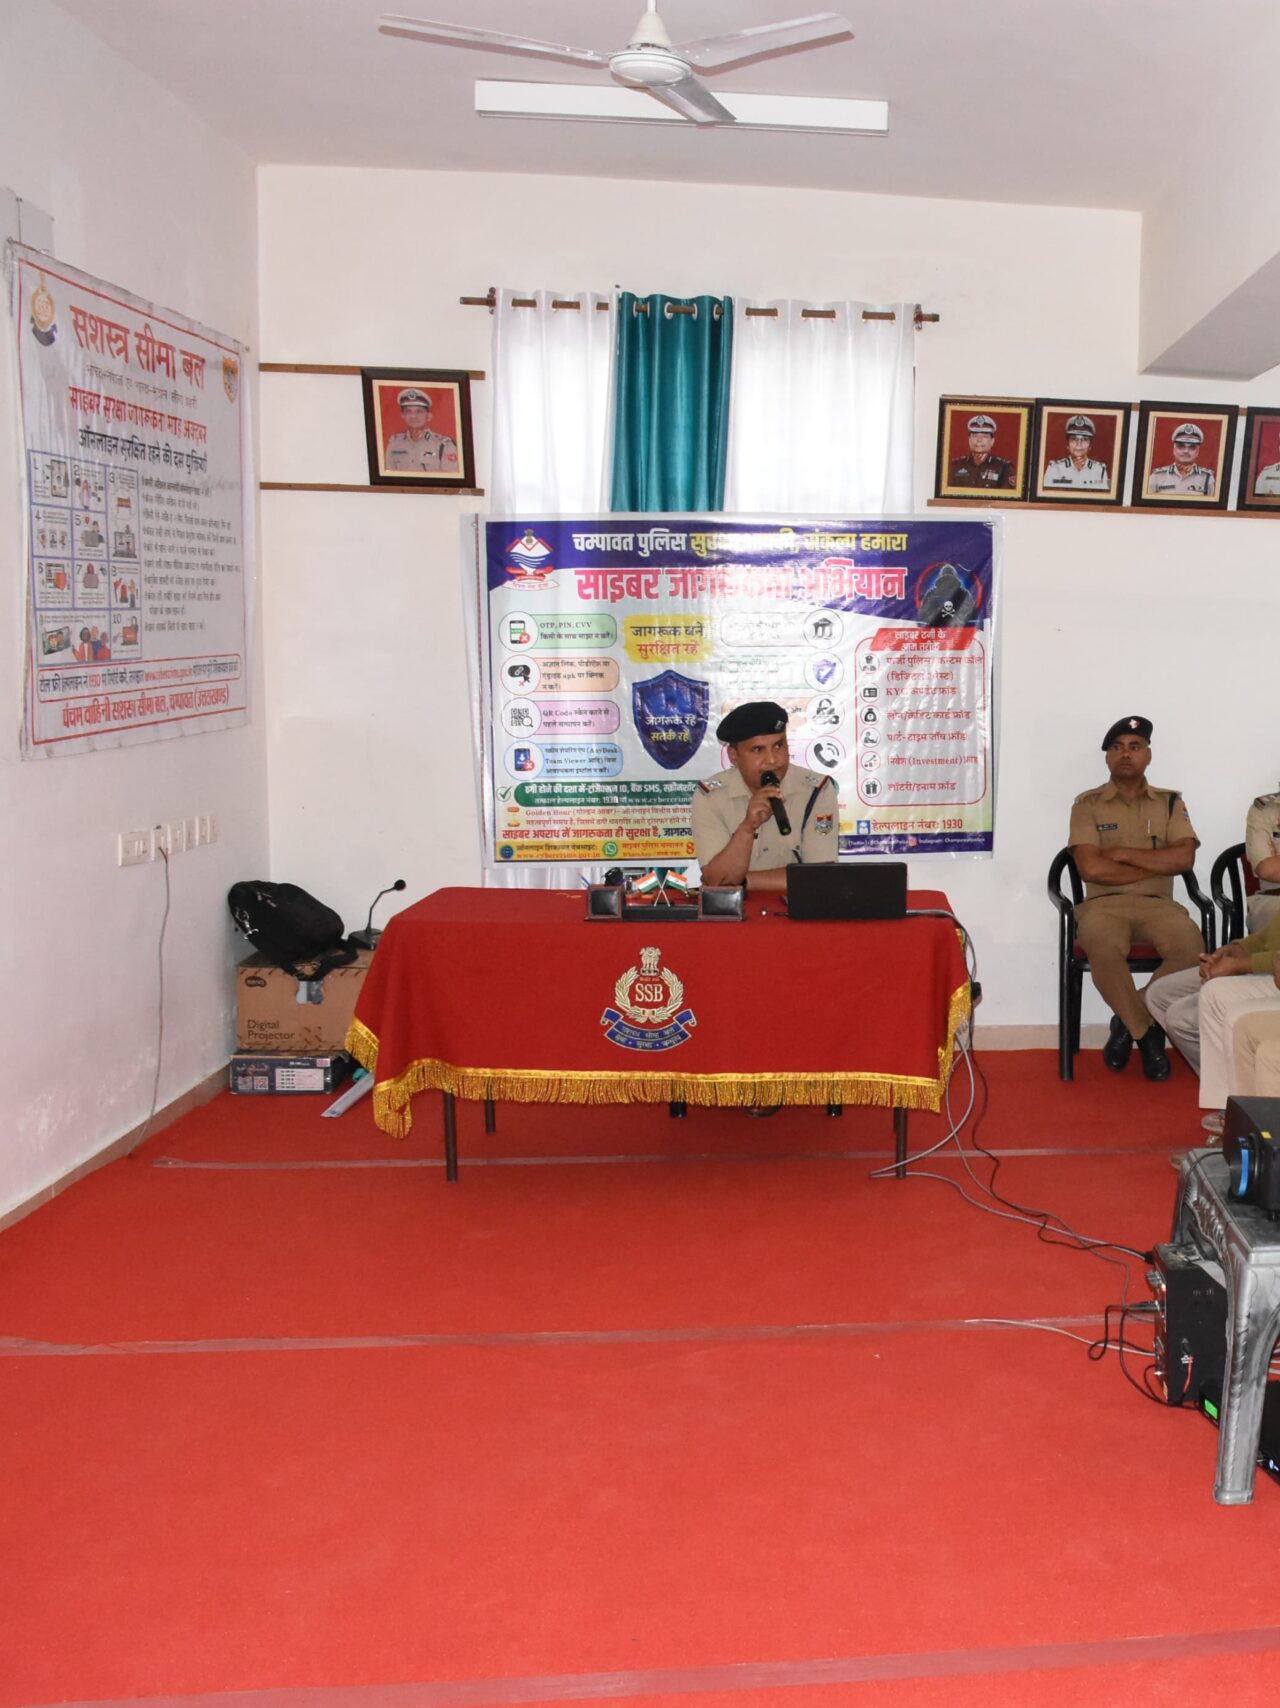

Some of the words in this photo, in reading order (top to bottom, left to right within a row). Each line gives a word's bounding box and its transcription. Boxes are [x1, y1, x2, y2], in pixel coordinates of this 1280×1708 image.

[69, 304, 129, 364] सशस्त्र
[134, 322, 176, 381] सीमा
[180, 349, 206, 390] बल
[68, 386, 101, 416] साइबर
[103, 395, 126, 423] सुरक्षा
[79, 425, 119, 457] ऑनलाइन
[120, 434, 146, 462] सुरक्षित
[148, 441, 160, 465] रहने
[162, 443, 172, 467] की
[173, 451, 184, 472] दस
[572, 533, 634, 552] चम्पावत
[637, 528, 687, 557] पुलिस
[860, 533, 908, 551] हमारा
[574, 569, 661, 603] साइबर
[113, 613, 122, 624] 10
[630, 625, 681, 637] जागरूक
[895, 631, 919, 640] साइबर
[921, 628, 936, 640] ठगी
[937, 628, 946, 639] के
[636, 640, 680, 659] सुरक्षित
[63, 703, 83, 728] पंचम
[83, 696, 111, 724] वाहिनी
[138, 692, 154, 716] सीमा
[555, 709, 572, 717] Code
[543, 720, 556, 728] पहले
[645, 714, 683, 726] जागरूक
[908, 755, 962, 766] (Investment)
[525, 783, 538, 794] ठगी
[538, 783, 552, 794] होने
[553, 783, 562, 793] की
[563, 785, 577, 793] दशा
[643, 784, 662, 793] SMS,
[872, 819, 915, 831] हेल्पलाइन
[943, 819, 963, 829] 1930
[502, 830, 530, 840] साइबर
[532, 829, 560, 839] अपराध
[561, 827, 570, 838] में
[615, 825, 623, 838] ही
[626, 828, 651, 840] सुरक्षा
[635, 983, 663, 1003] SSB
[247, 1019, 279, 1031] Digital
[247, 1030, 295, 1041] Projector
